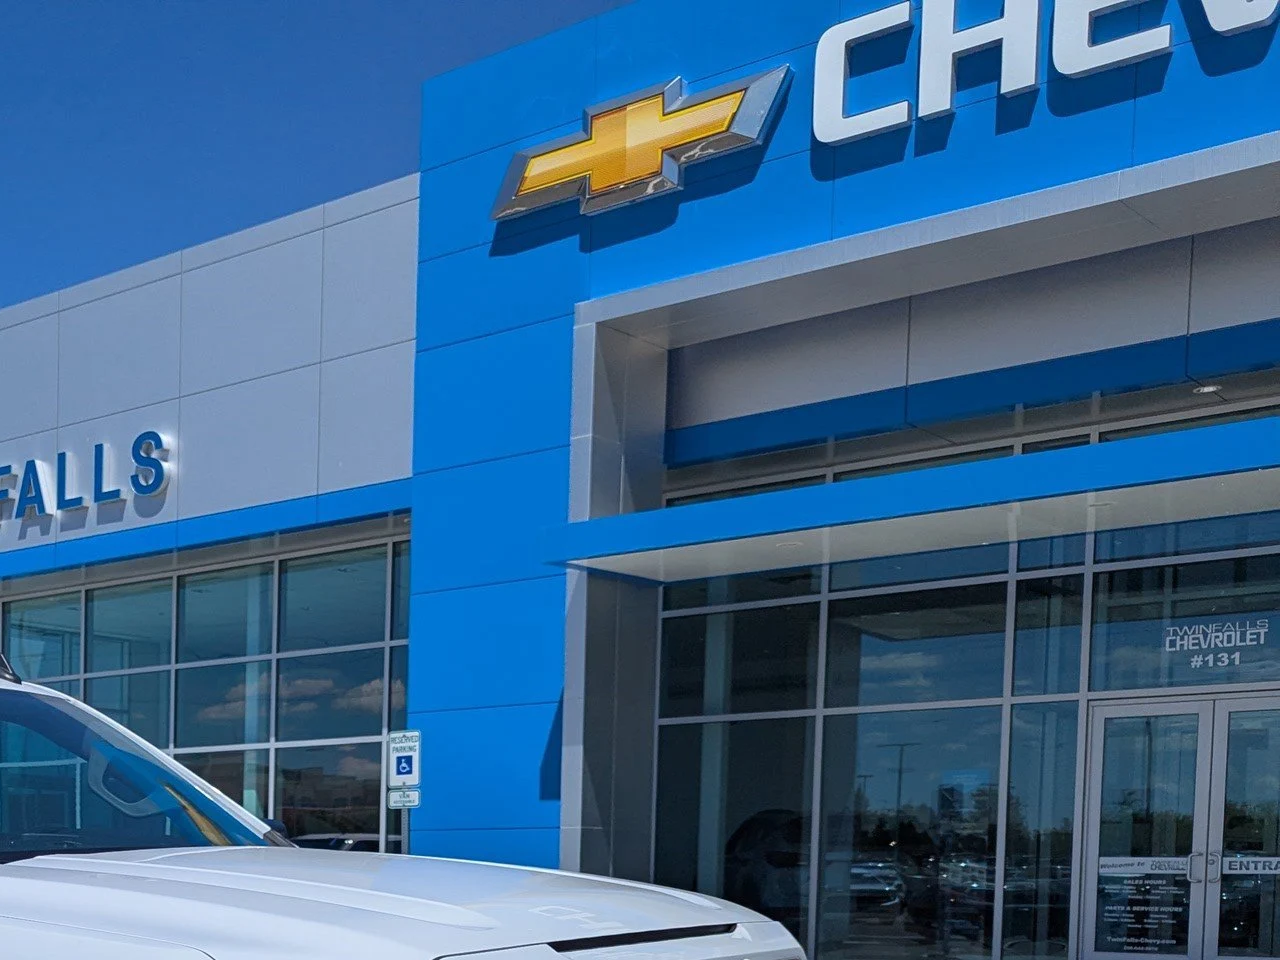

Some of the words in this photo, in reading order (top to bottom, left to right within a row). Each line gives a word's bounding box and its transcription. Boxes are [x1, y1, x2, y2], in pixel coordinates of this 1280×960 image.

[813, 0, 1280, 146] CHE
[1165, 628, 1269, 652] CHEVROLET
[1190, 652, 1240, 669] #131
[390, 735, 418, 744] RESERVED
[392, 745, 417, 753] PARKING
